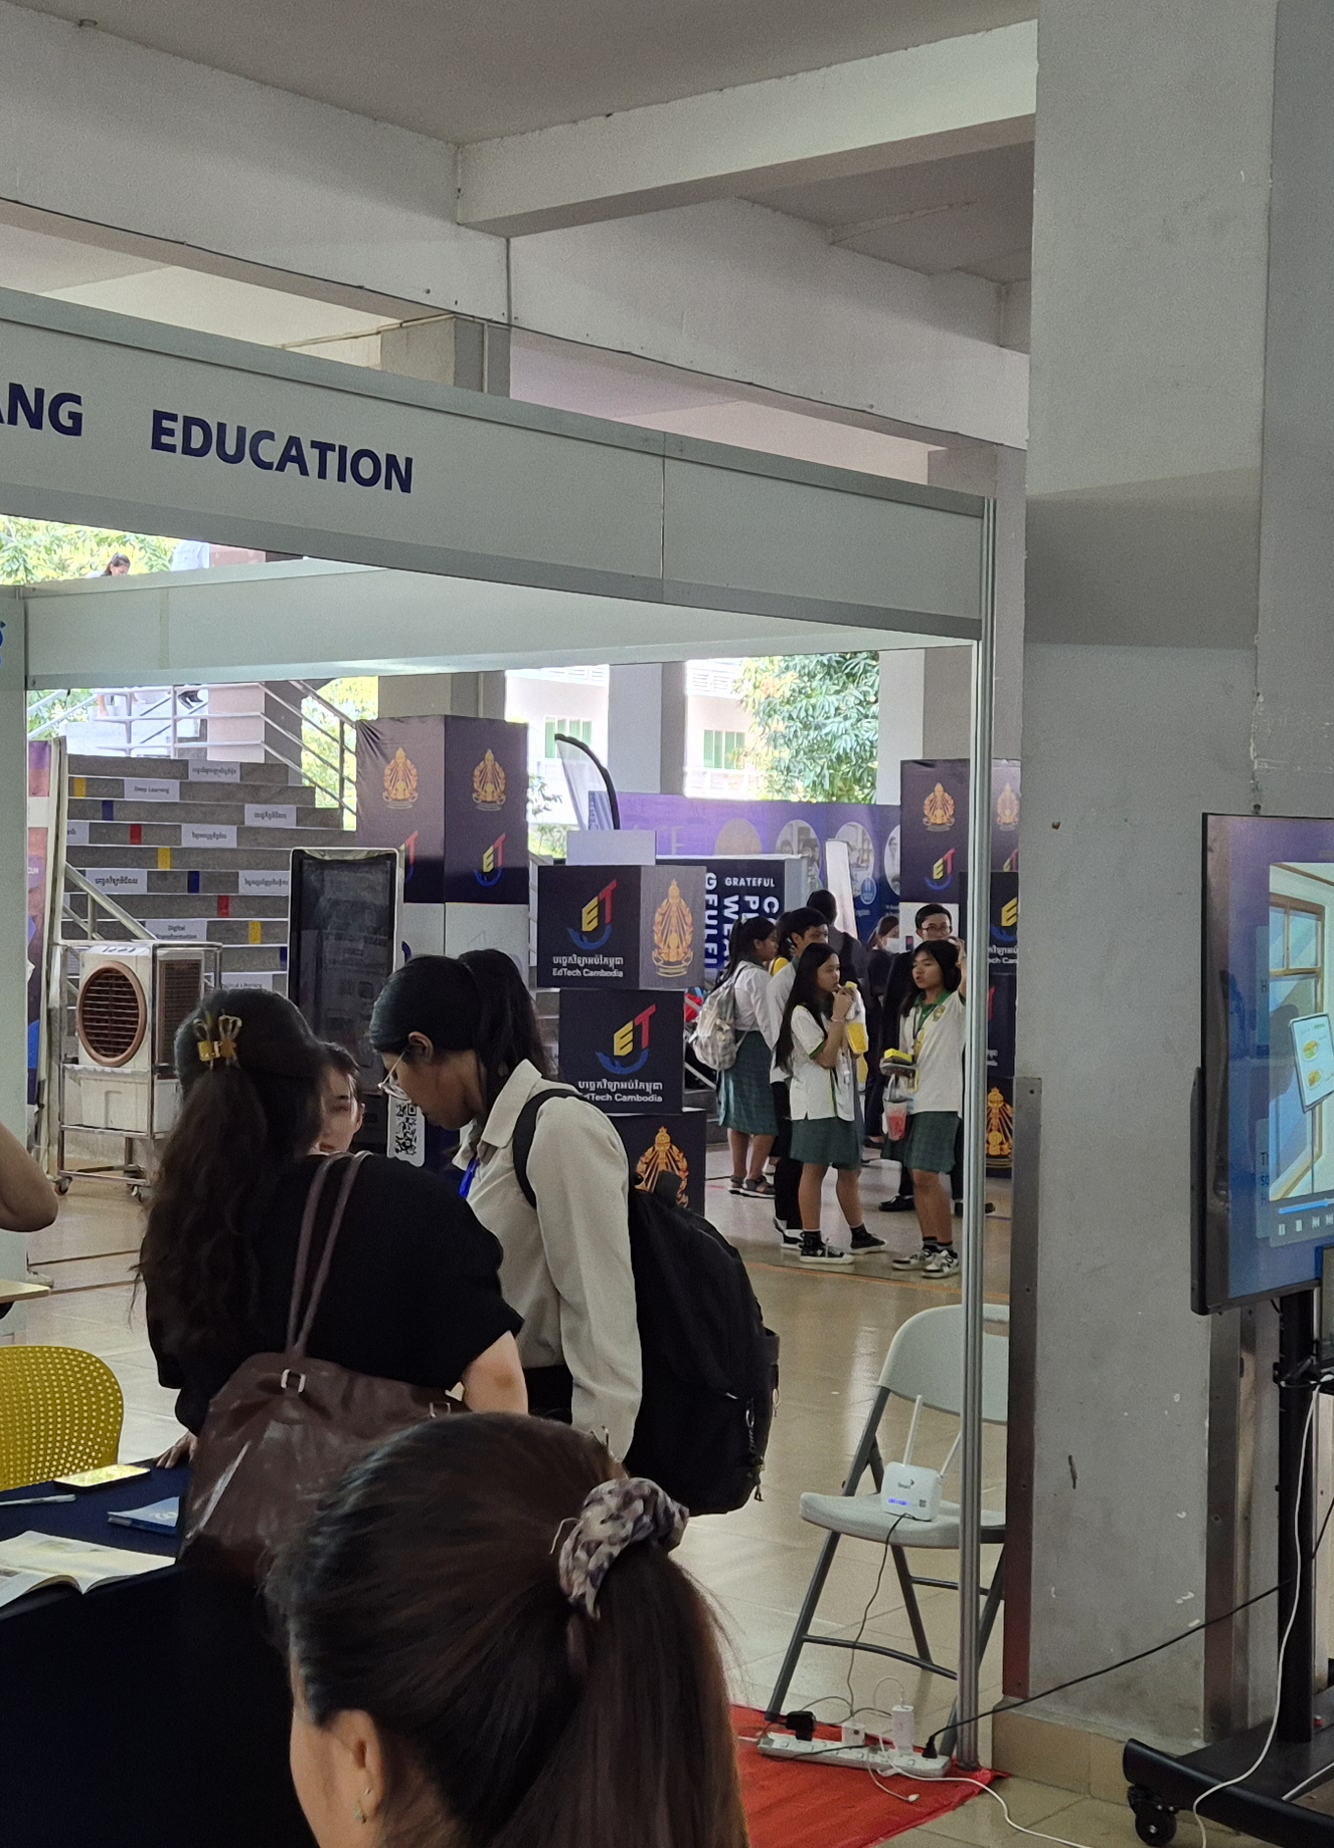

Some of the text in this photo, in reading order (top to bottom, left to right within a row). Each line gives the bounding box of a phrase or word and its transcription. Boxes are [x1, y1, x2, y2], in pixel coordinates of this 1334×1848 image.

[150, 409, 414, 493] EDUCATION
[725, 876, 776, 887] GRATEFUL
[552, 967, 624, 978] EdTech Cambodia
[614, 1093, 663, 1103] Cambodia
